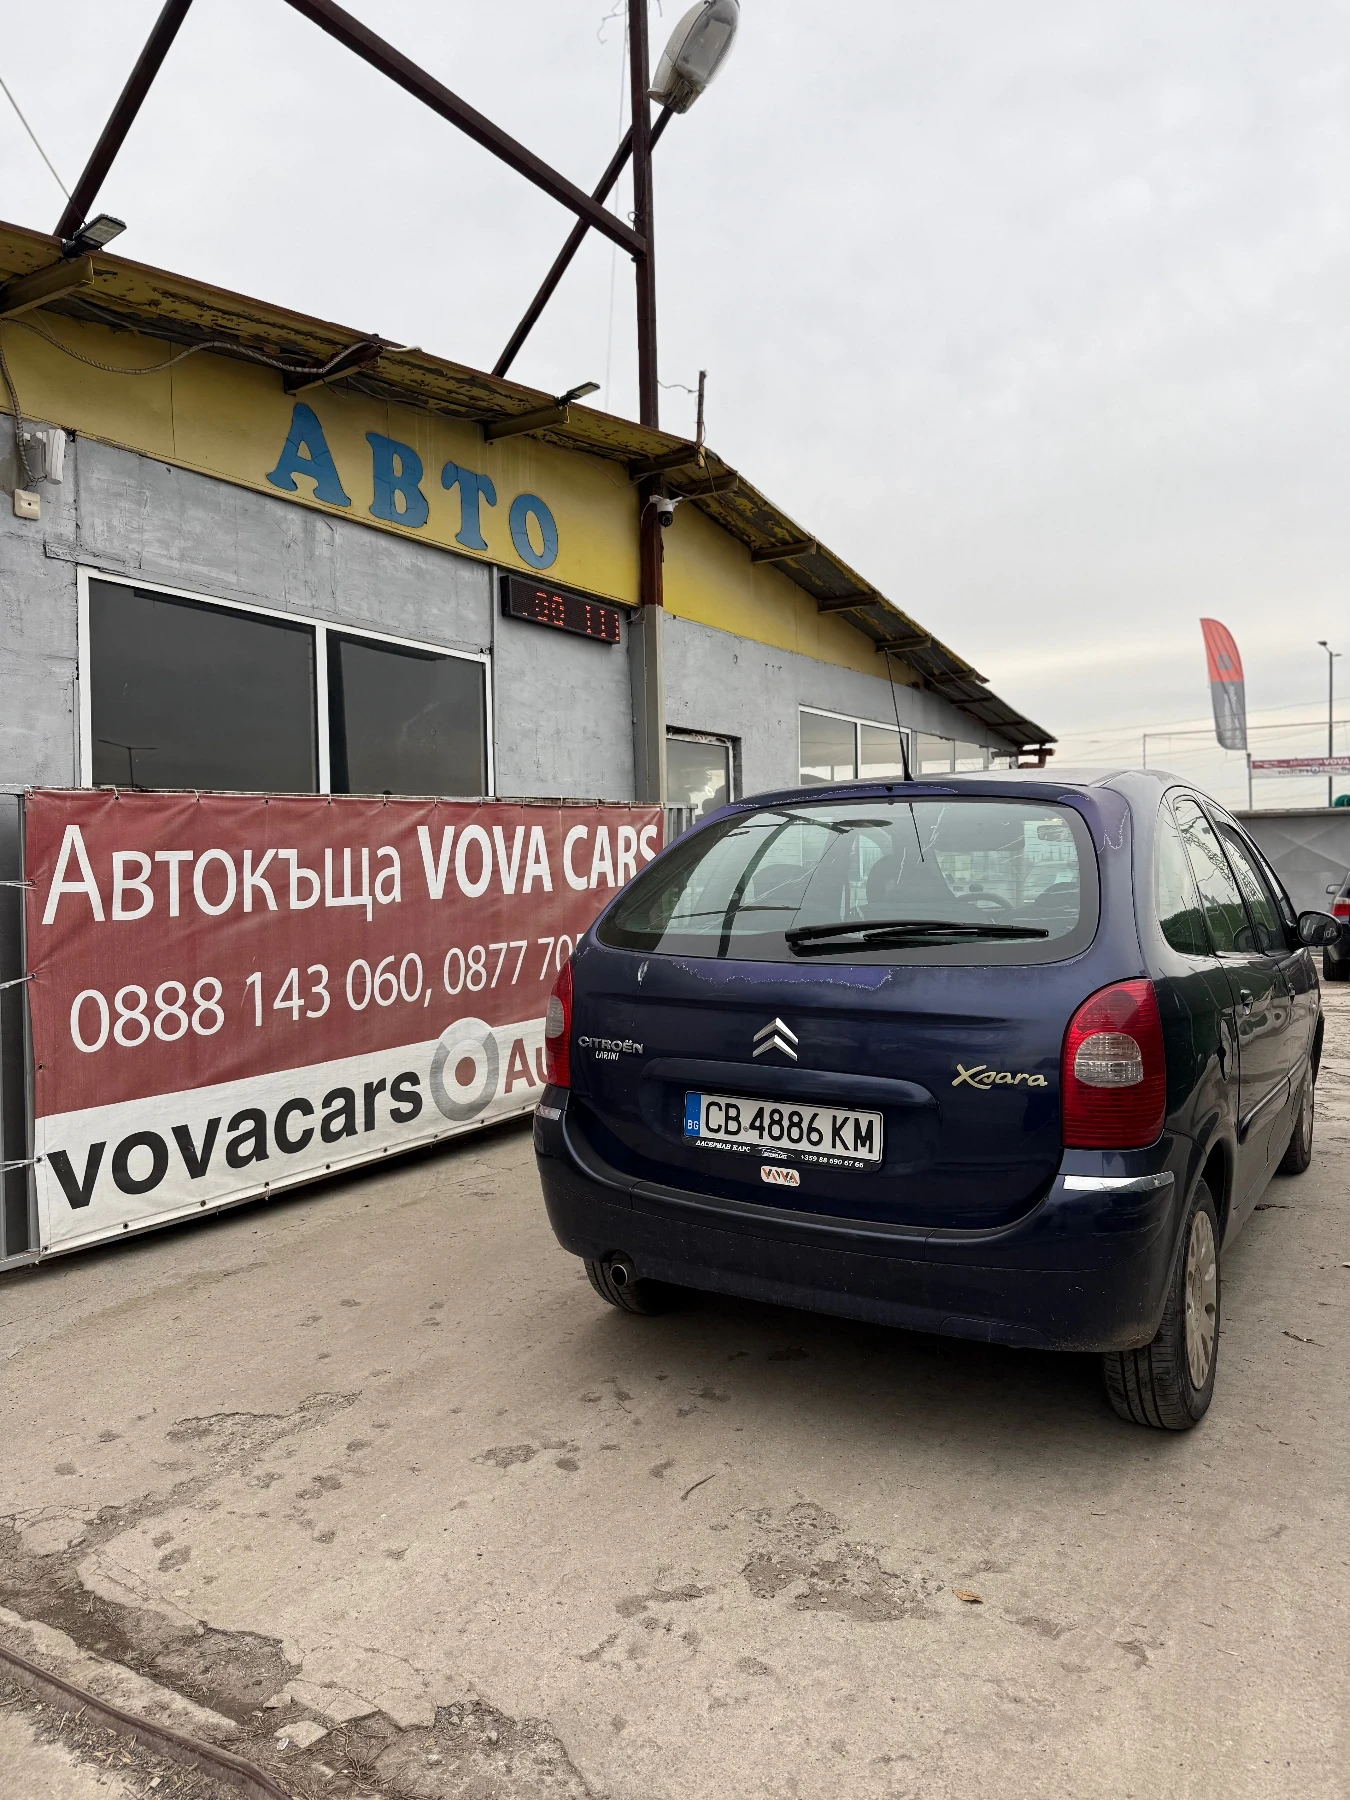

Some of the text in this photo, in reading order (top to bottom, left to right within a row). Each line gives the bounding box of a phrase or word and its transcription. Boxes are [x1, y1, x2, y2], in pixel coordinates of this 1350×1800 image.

[266, 402, 559, 570] АВТО
[42, 825, 657, 925] Автокъща VOVA CARS
[70, 934, 585, 1053] 0888 143 060, 0877 70
[578, 1035, 643, 1054] CITROËN
[951, 1063, 1048, 1090] Xsara
[47, 1071, 423, 1210] vovacars
[687, 1119, 699, 1131] BG
[749, 1106, 824, 1147] 4886
[831, 1114, 874, 1154] KM
[800, 1154, 817, 1162] +359
